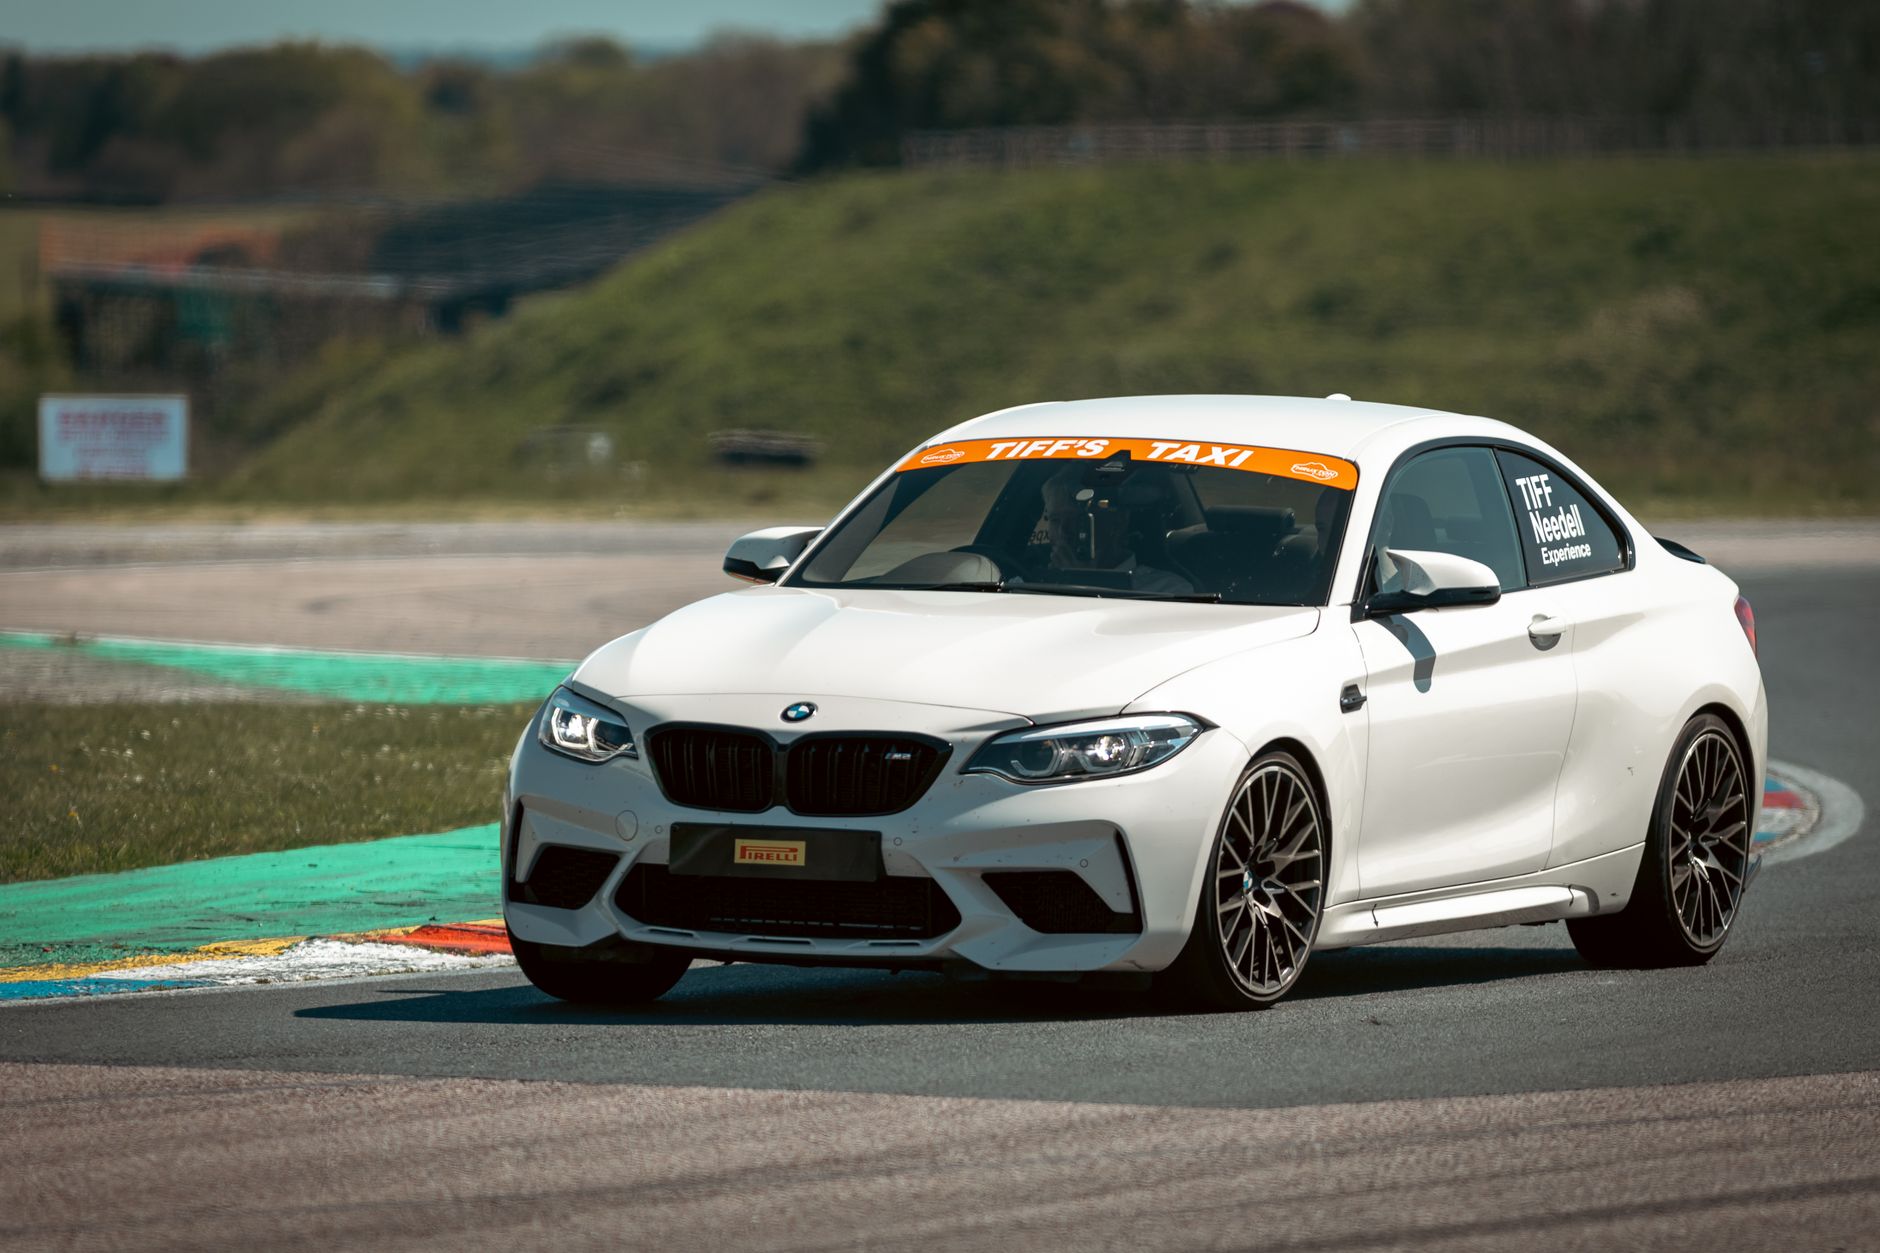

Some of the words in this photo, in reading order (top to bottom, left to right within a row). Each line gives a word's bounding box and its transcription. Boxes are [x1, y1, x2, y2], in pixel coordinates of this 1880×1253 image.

[986, 440, 1110, 459] TIFF'S
[1146, 442, 1255, 467] TAXI
[1515, 473, 1552, 510] TIFF
[1529, 504, 1585, 543] Needell
[1541, 543, 1591, 566] Experience
[739, 845, 798, 862] PIRELLI
